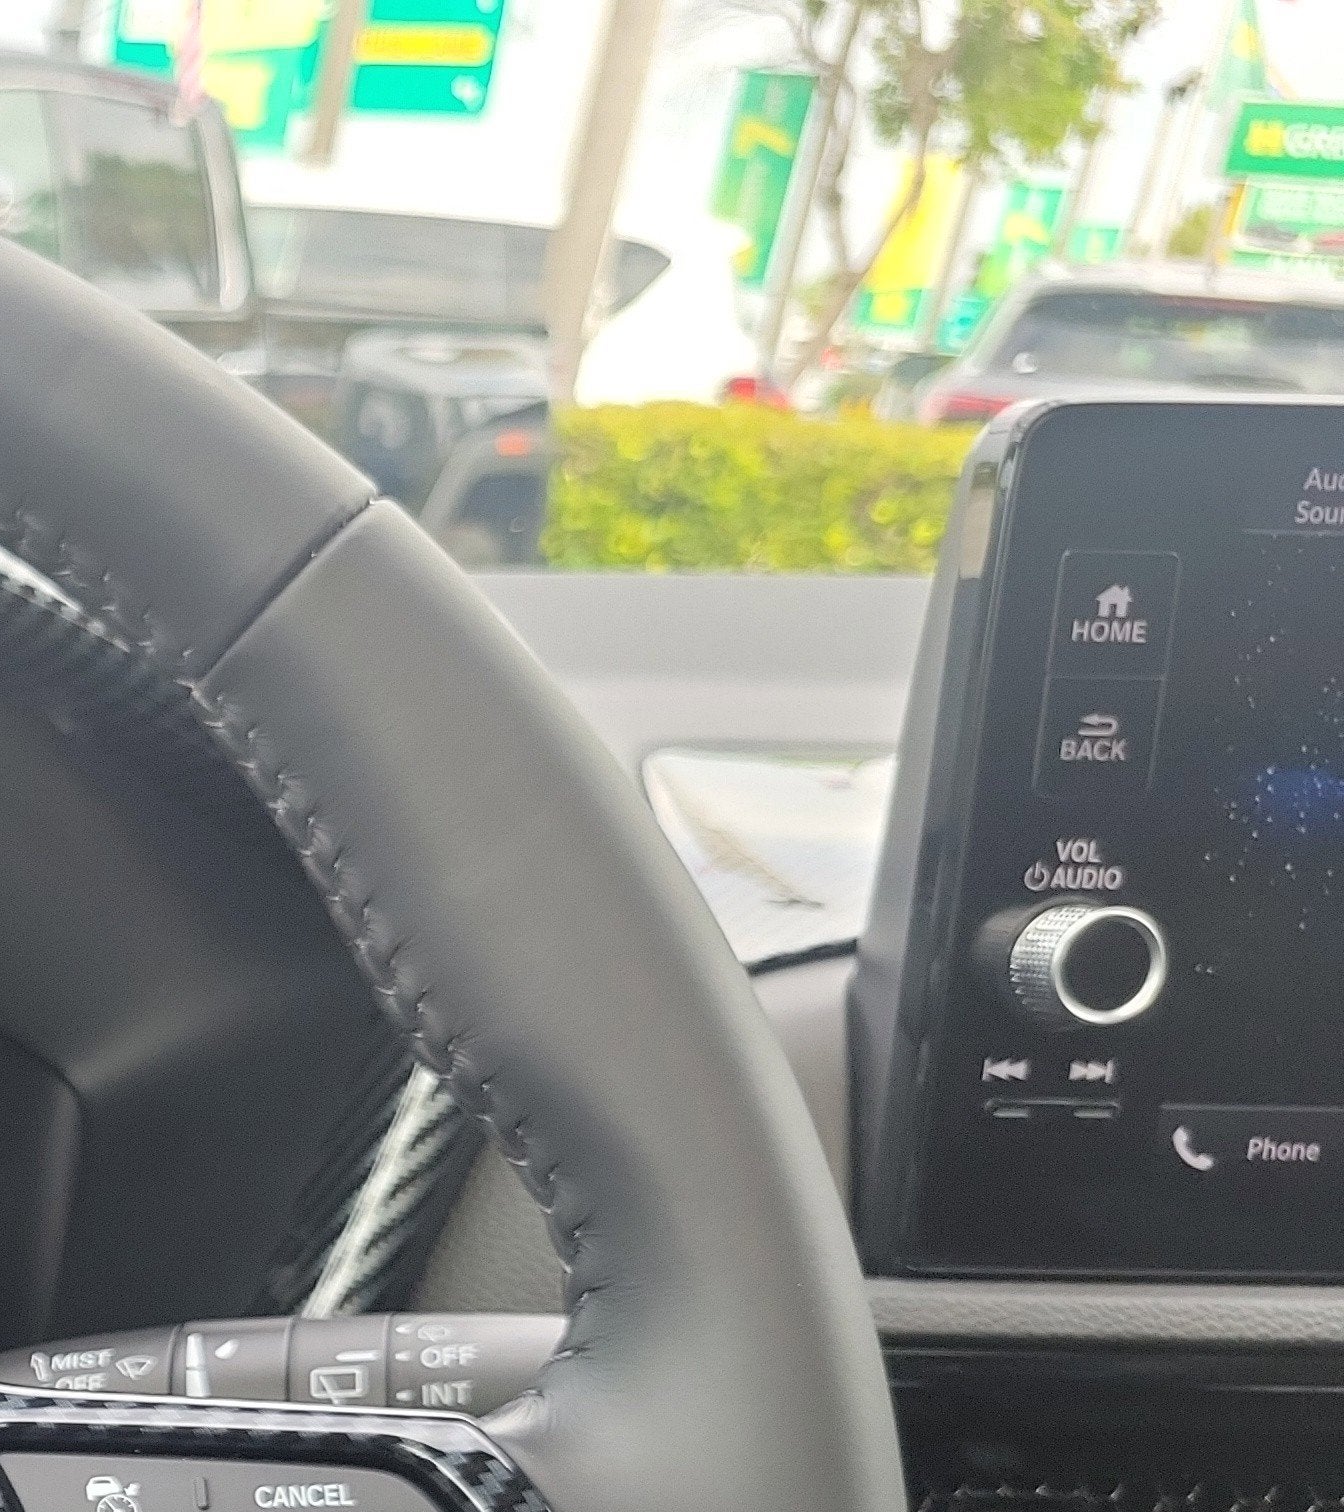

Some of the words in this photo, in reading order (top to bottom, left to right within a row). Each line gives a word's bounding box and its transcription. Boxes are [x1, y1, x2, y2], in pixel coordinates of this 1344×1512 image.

[1071, 619, 1148, 644] HOME
[1060, 738, 1127, 762] BACK
[1055, 838, 1102, 863] VOL
[1049, 866, 1124, 890] AUDIO
[1247, 1137, 1321, 1162] Phone
[52, 1349, 115, 1372] MIST
[420, 1343, 480, 1369] OFF
[421, 1380, 474, 1407] INT
[254, 1483, 356, 1509] CANCEL
